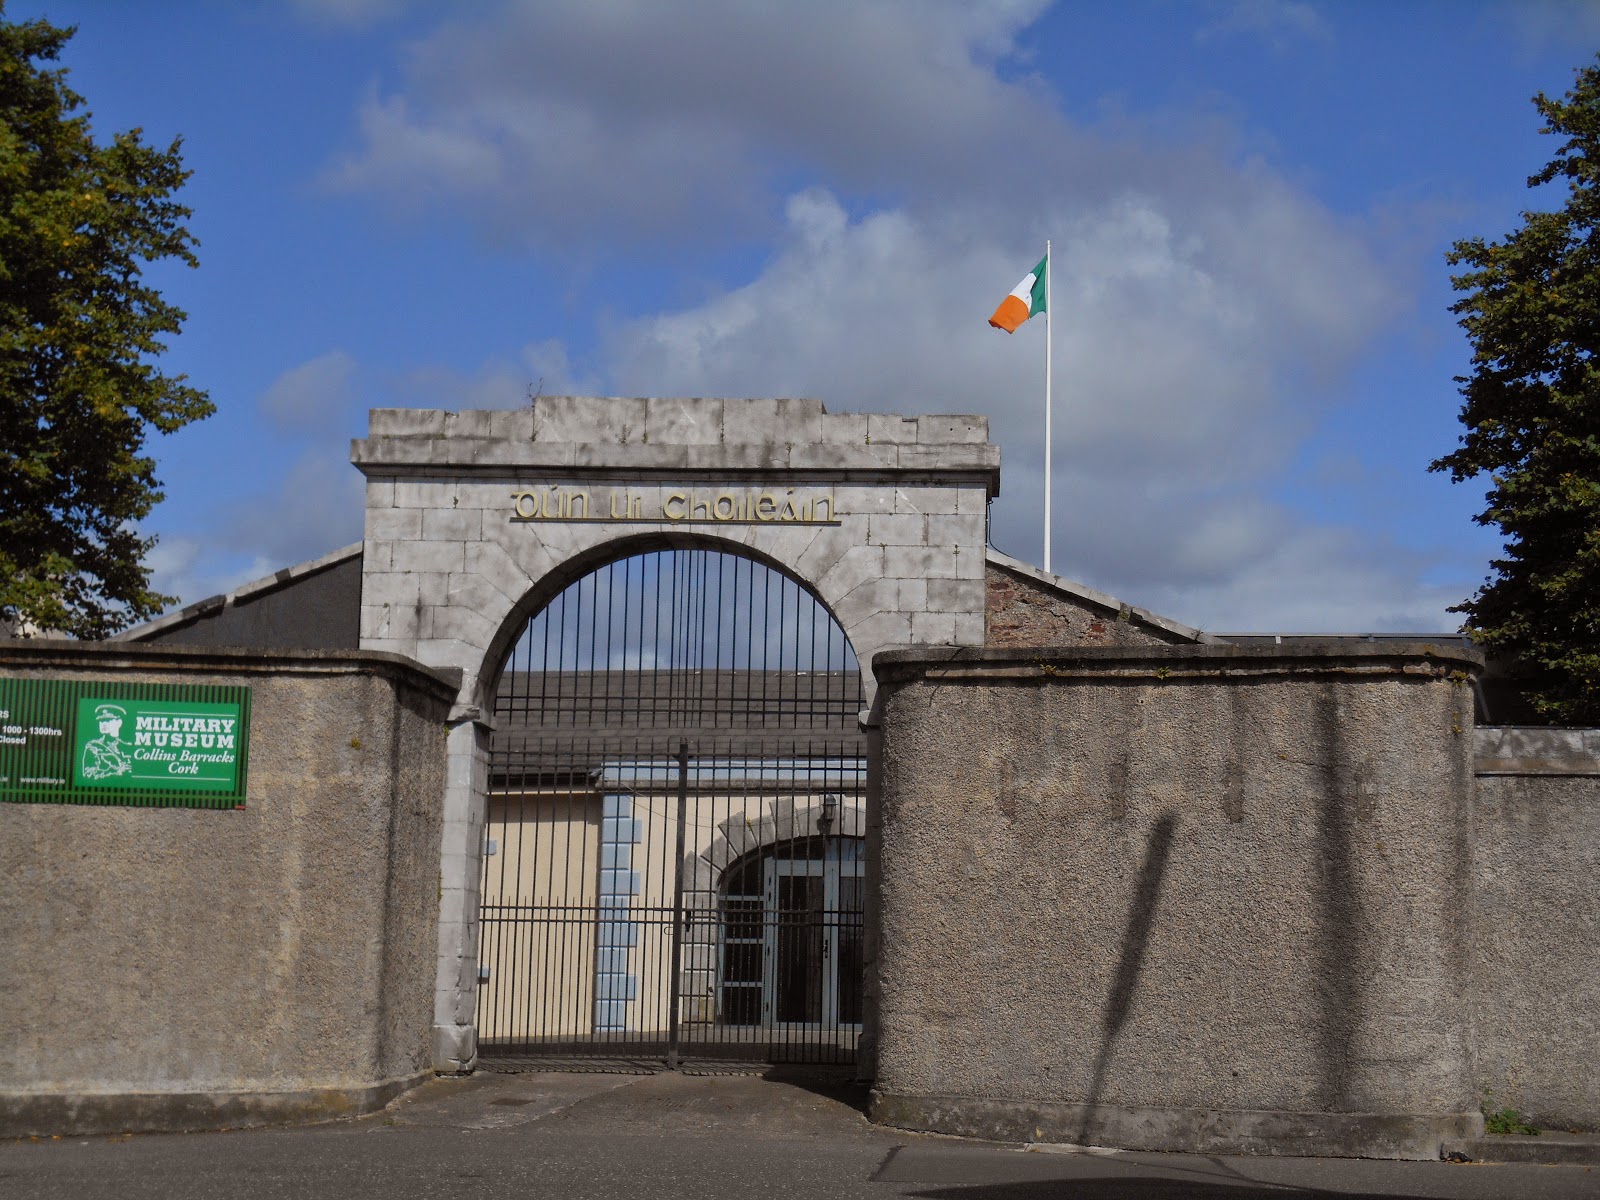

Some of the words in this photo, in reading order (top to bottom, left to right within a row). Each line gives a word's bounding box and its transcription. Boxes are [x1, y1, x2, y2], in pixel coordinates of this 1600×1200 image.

[2, 725, 22, 734] 1000
[29, 727, 62, 736] 1300hrs
[135, 716, 236, 733] MILITARY
[134, 731, 235, 749] MUSEUM
[133, 747, 177, 761] Collins
[179, 749, 235, 763] Barracks
[168, 761, 199, 775] Cork
[20, 776, 66, 786] www.military.ie
